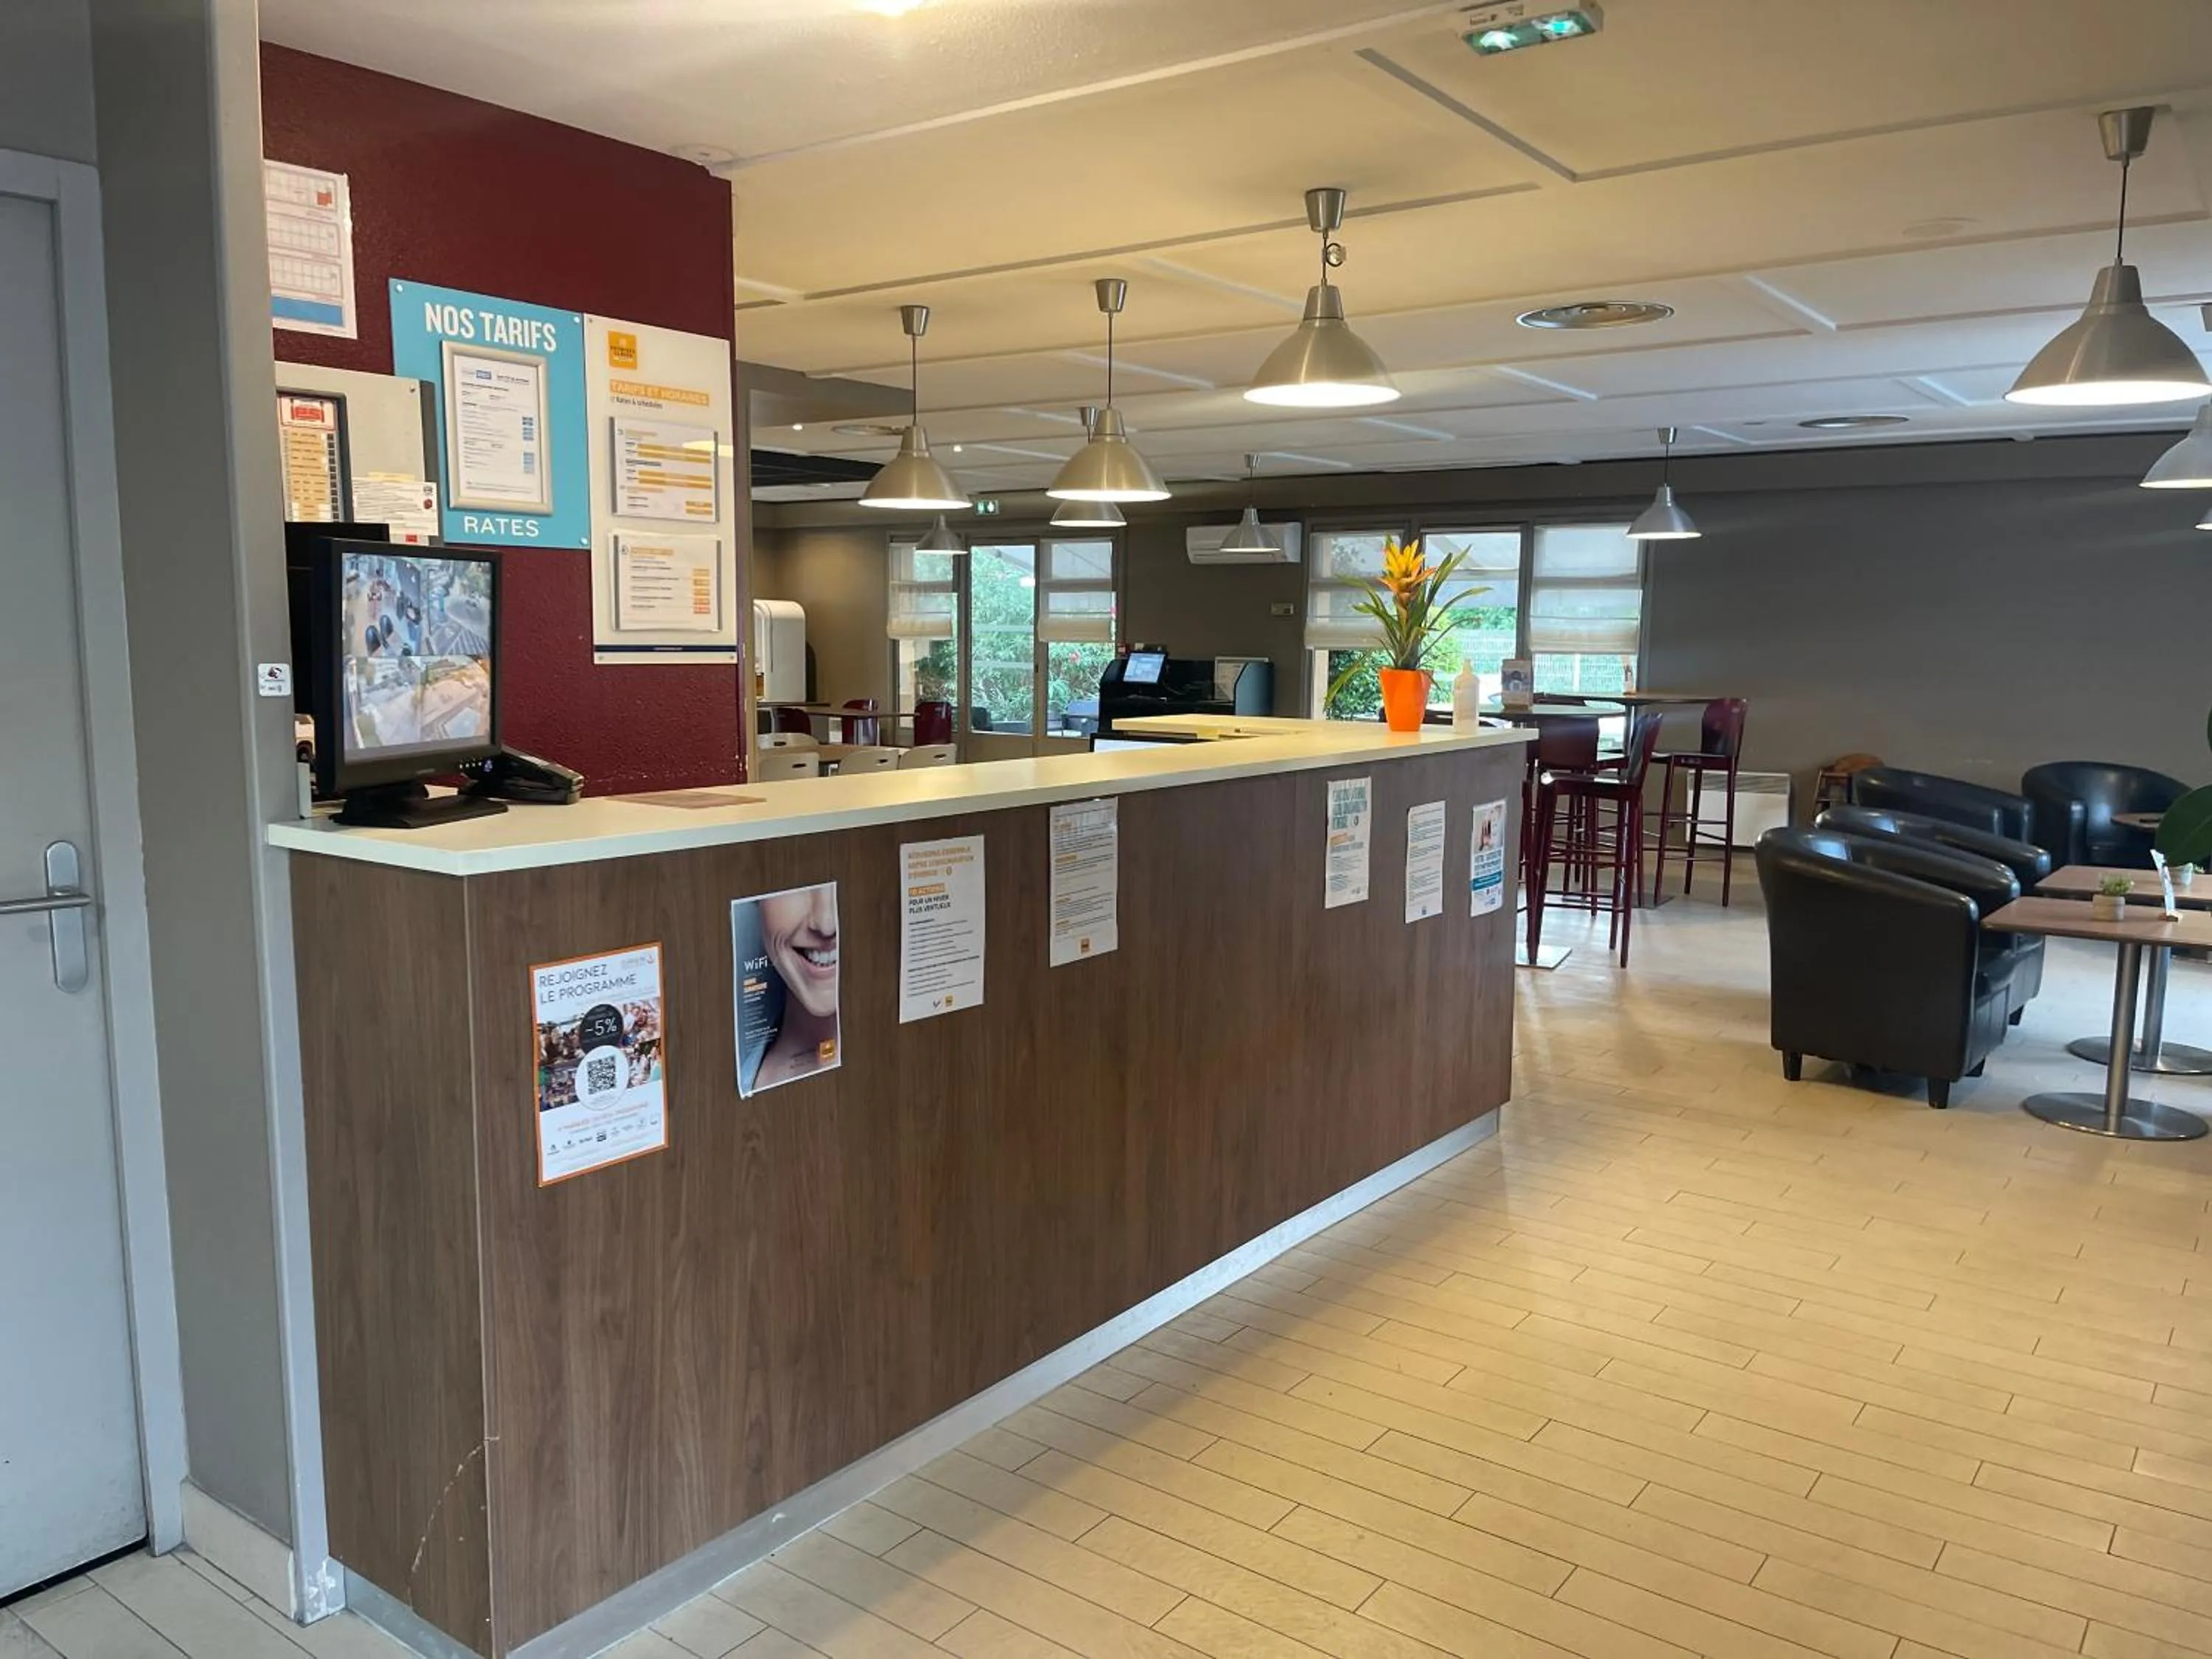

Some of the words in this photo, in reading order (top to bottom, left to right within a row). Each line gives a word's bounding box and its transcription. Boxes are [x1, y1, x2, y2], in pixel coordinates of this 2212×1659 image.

[424, 302, 475, 339] NOS
[479, 310, 557, 352] TARIFS
[464, 515, 540, 538] RATES
[744, 955, 768, 972] WiFi
[539, 964, 608, 987] REJOIGNEZ
[540, 990, 555, 1004] LE
[559, 973, 637, 999] PROGRAMME
[585, 1017, 617, 1037] -5%
